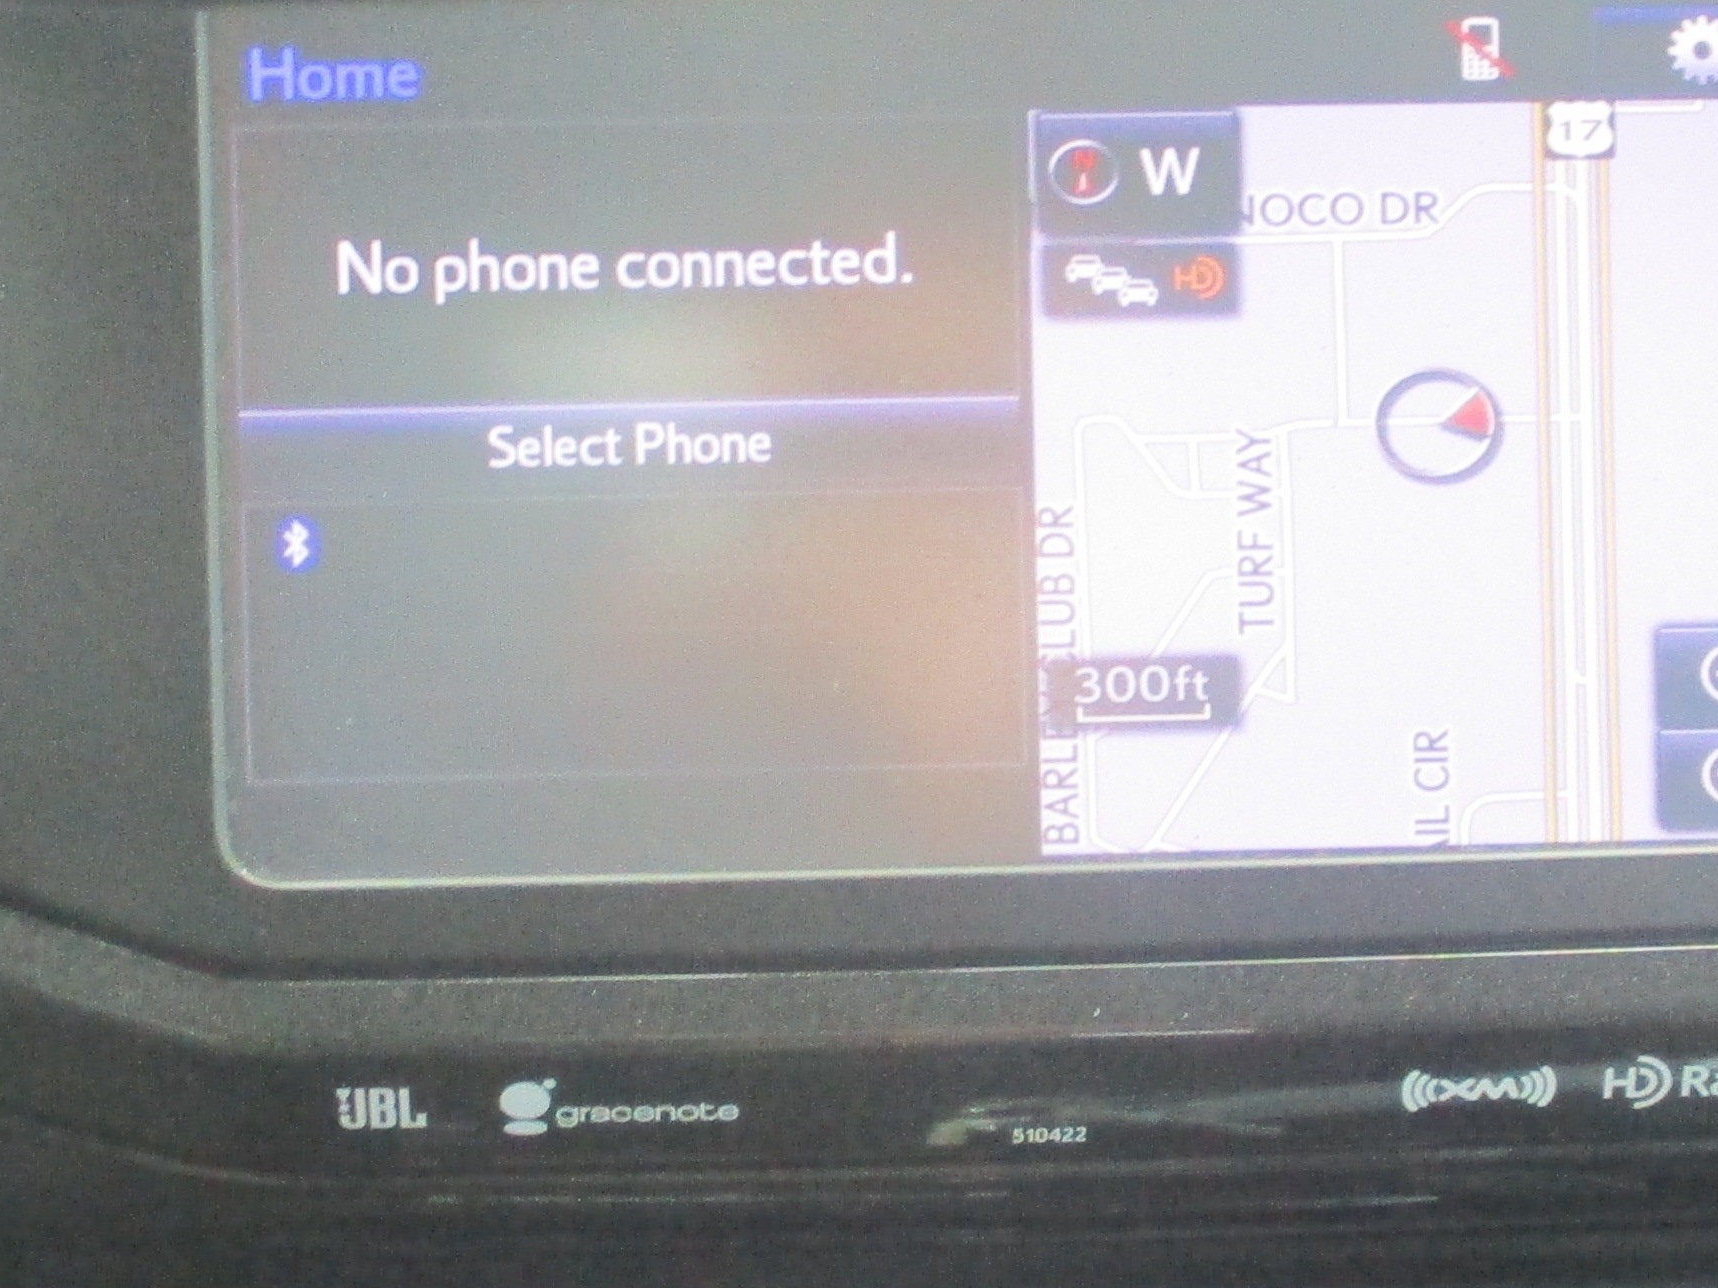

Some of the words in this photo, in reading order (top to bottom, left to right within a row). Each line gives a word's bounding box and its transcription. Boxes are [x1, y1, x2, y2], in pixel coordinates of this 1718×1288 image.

[246, 47, 422, 103] Home
[1558, 118, 1603, 142] 17
[1140, 146, 1200, 196] W
[1381, 191, 1441, 225] DR
[335, 240, 419, 295] No
[434, 238, 600, 306] phone
[615, 231, 915, 289] connected.
[487, 425, 621, 469] Select
[635, 423, 773, 466] Phone
[1236, 428, 1272, 517] WAY
[1039, 505, 1075, 558] DR
[1238, 530, 1274, 634] TURF
[1040, 573, 1076, 662] LUB
[1074, 664, 1210, 704] 300ft
[1413, 728, 1450, 792] CIR
[1602, 1055, 1673, 1109] HD
[336, 1087, 427, 1129] JBL
[556, 1102, 740, 1128] gracenote
[1012, 1126, 1087, 1144] 510422
